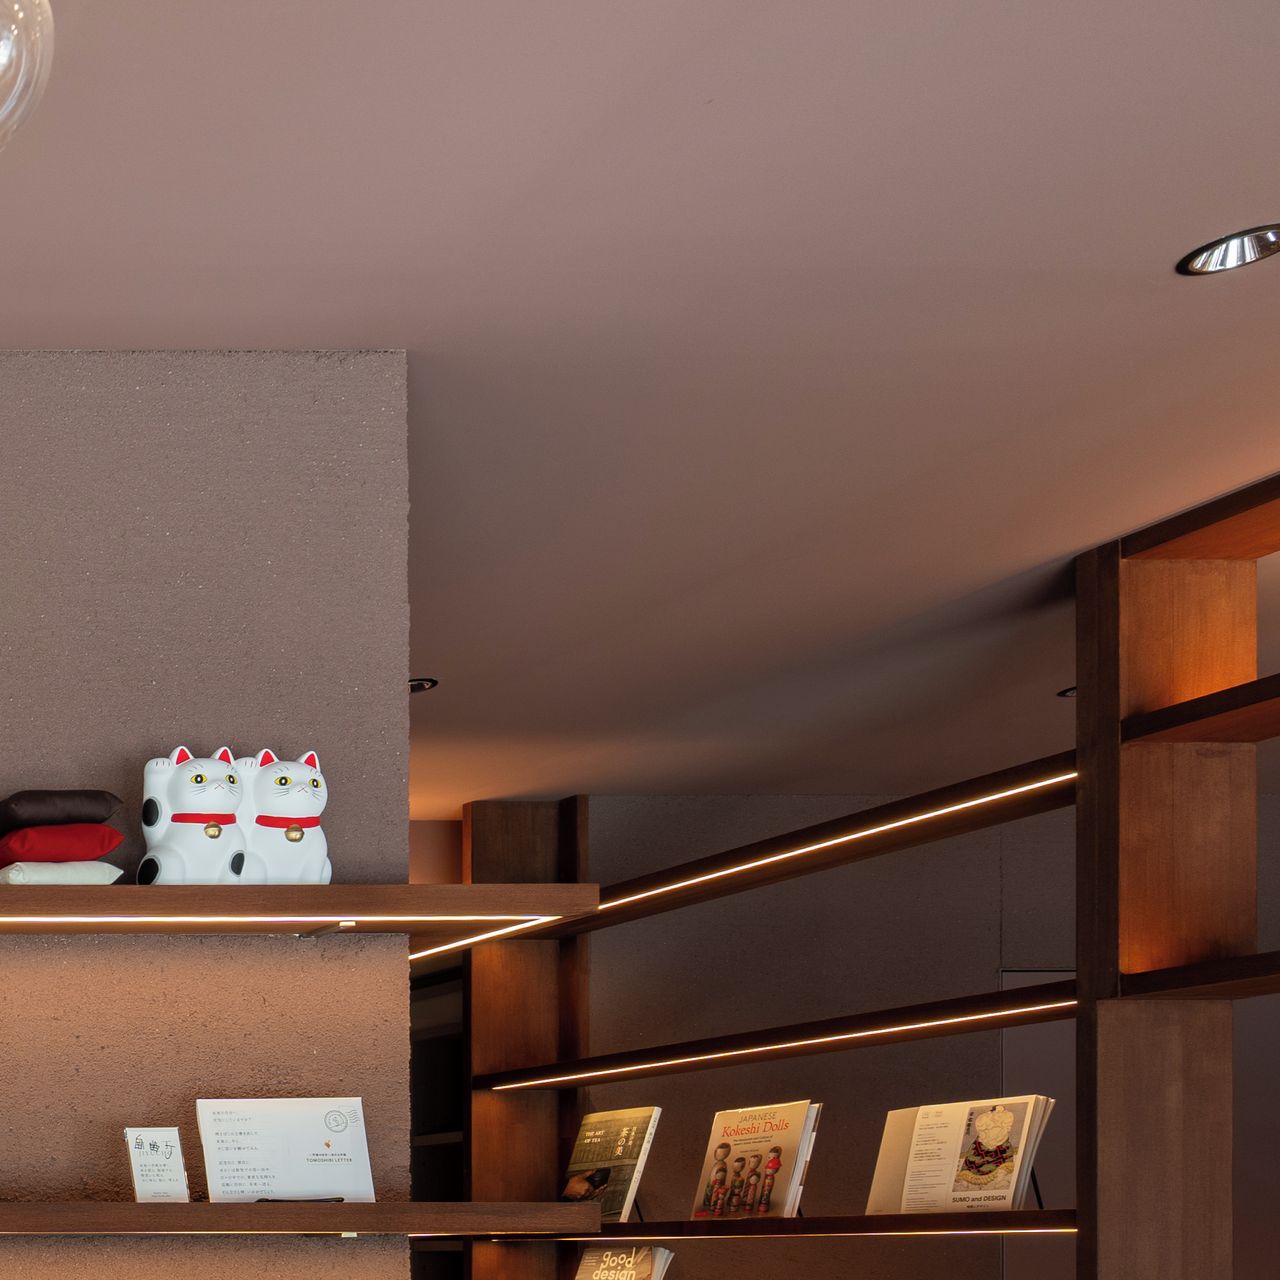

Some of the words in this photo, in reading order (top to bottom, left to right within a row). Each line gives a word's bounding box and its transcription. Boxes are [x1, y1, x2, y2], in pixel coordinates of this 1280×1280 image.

[738, 1111, 777, 1123] JAPANESE
[721, 1123, 760, 1138] Kokeshi
[762, 1119, 790, 1133] Dolls
[615, 1127, 630, 1156] 茶の美
[983, 1194, 1007, 1202] DESIGN
[600, 1247, 636, 1269] good
